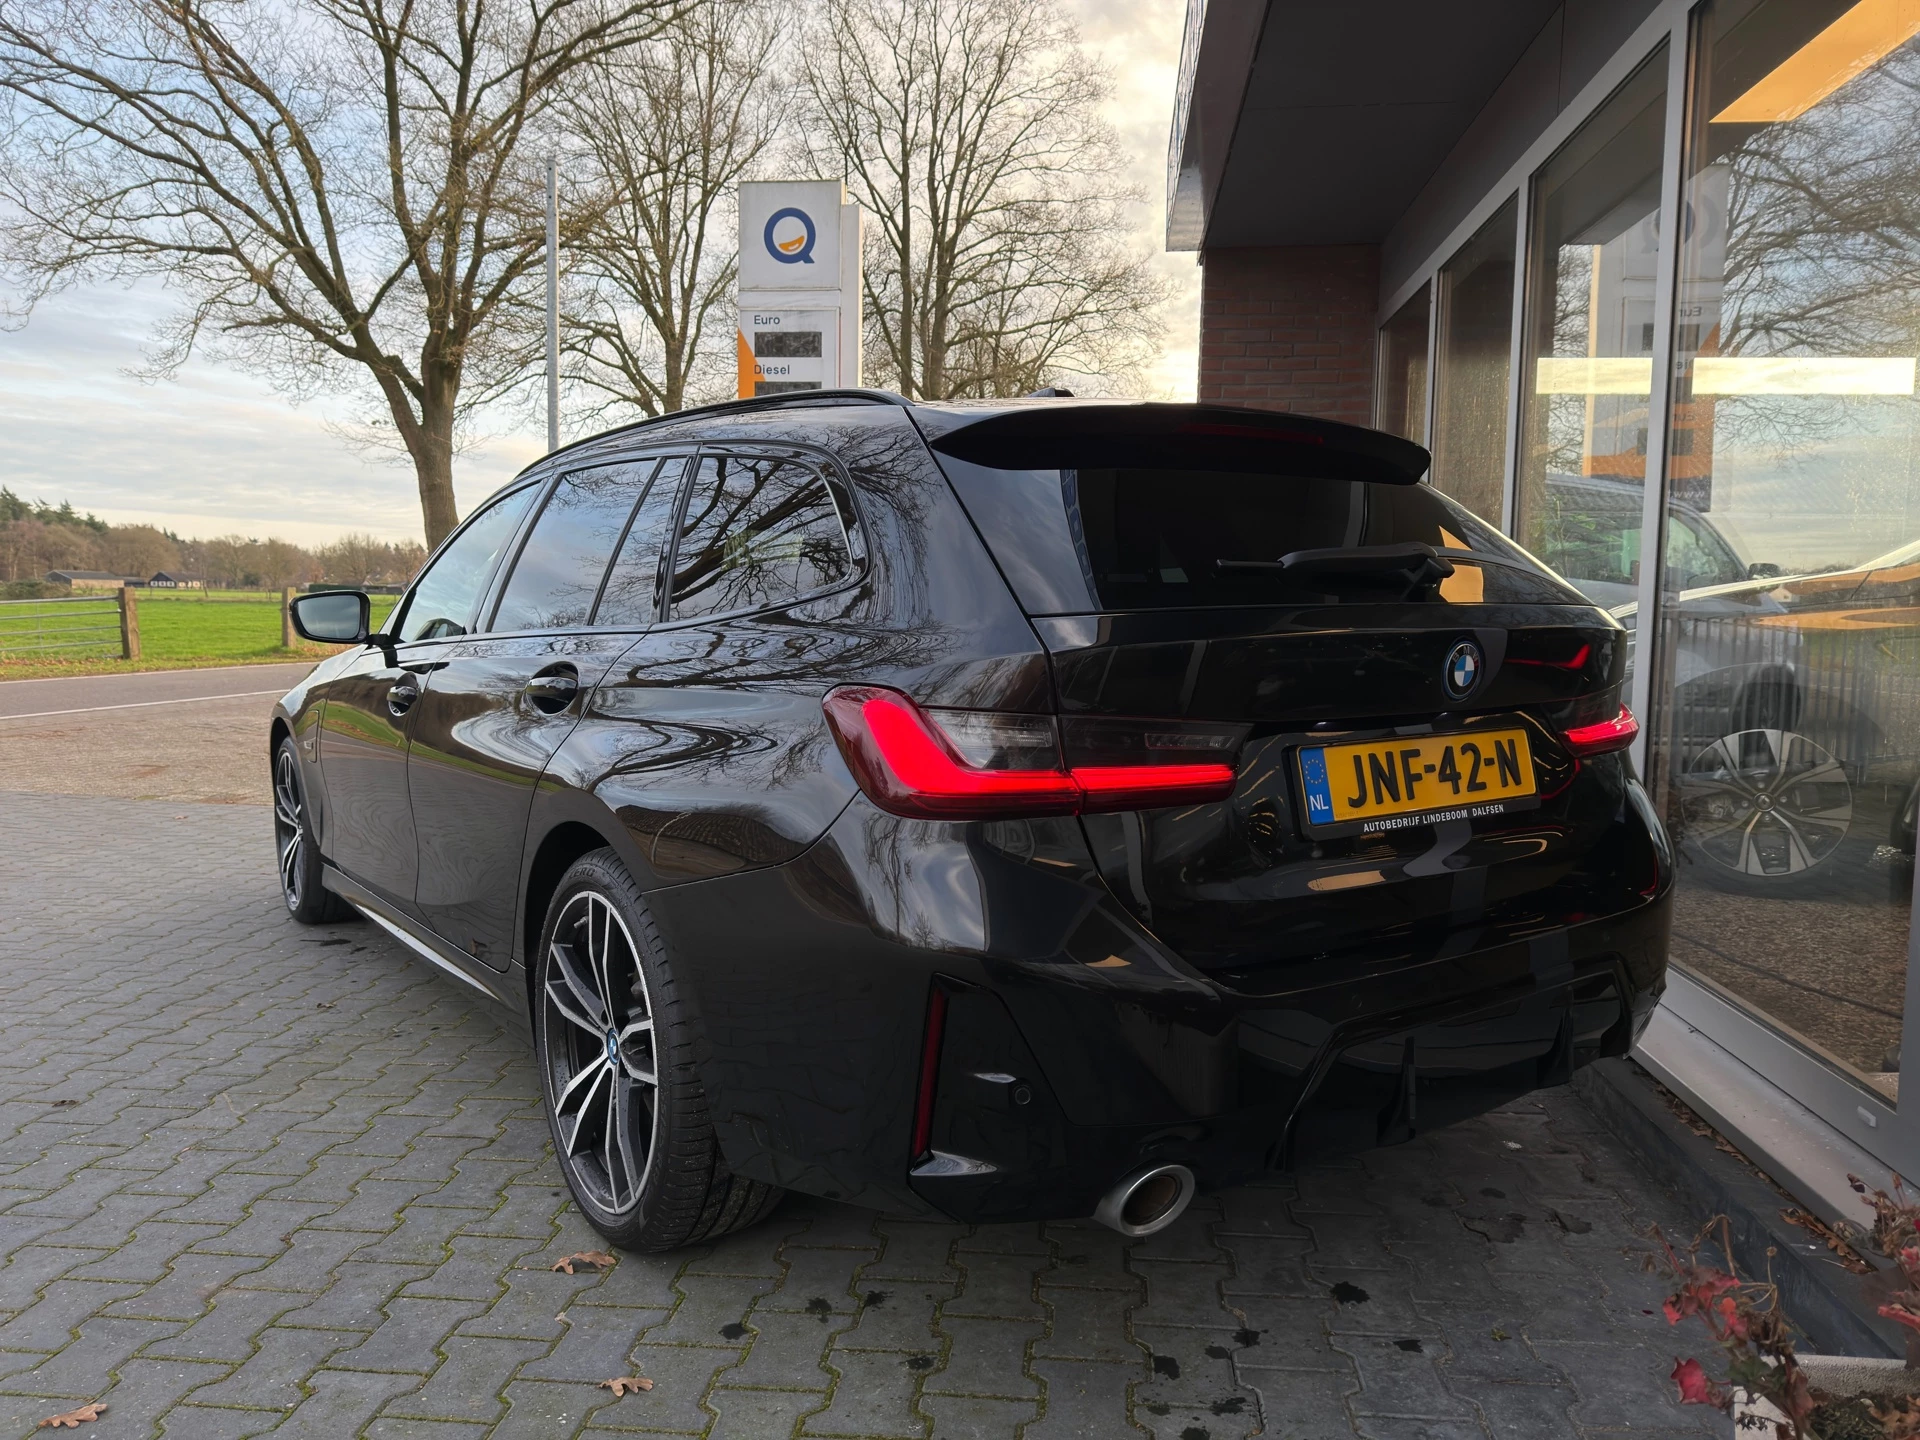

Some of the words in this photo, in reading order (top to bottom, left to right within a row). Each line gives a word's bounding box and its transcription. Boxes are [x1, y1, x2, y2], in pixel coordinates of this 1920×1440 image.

[764, 207, 816, 264] Q
[754, 315, 781, 325] Euro
[754, 364, 790, 375] Diesel
[1452, 645, 1479, 663] BMW
[1348, 739, 1522, 808] JNF-42-N
[1310, 794, 1329, 811] NL
[1363, 816, 1420, 832] AUTOBEDRIJF
[1422, 809, 1468, 824] LINDEBOOM
[1472, 799, 1504, 816] DALFSEN
